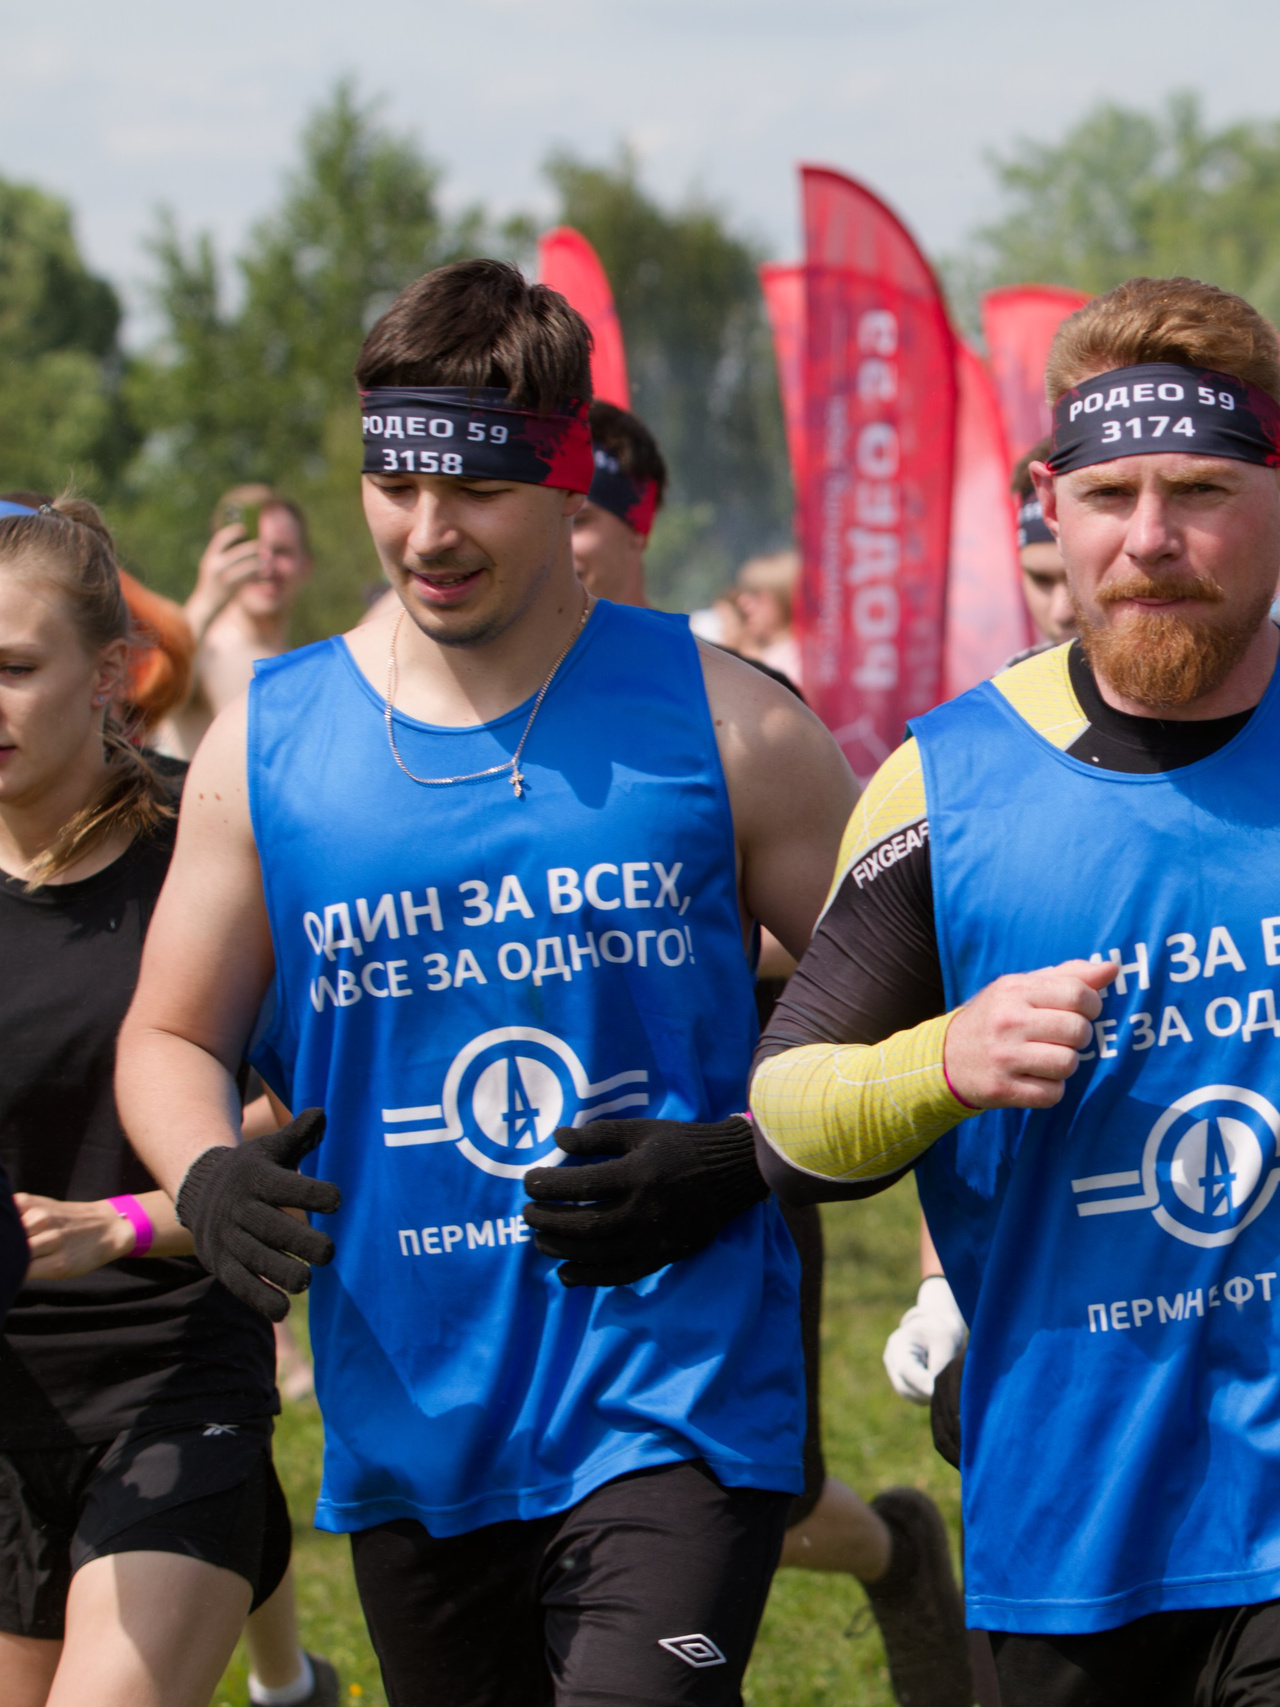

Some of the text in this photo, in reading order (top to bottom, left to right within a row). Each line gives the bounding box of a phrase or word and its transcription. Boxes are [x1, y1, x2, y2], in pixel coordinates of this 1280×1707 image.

[1069, 383, 1235, 422] РОДЕО 59
[466, 422, 508, 445] 59
[1101, 415, 1196, 443] 3174
[382, 448, 464, 475] 3158
[303, 861, 691, 961] ОДИН ЗА ВСЕХ,
[422, 948, 488, 991] ЗА
[497, 924, 696, 987] ОДНОГО!
[1165, 925, 1247, 984] ЗА
[1130, 1004, 1194, 1052] ЗА
[398, 1214, 532, 1257] ПЕРМНЕ
